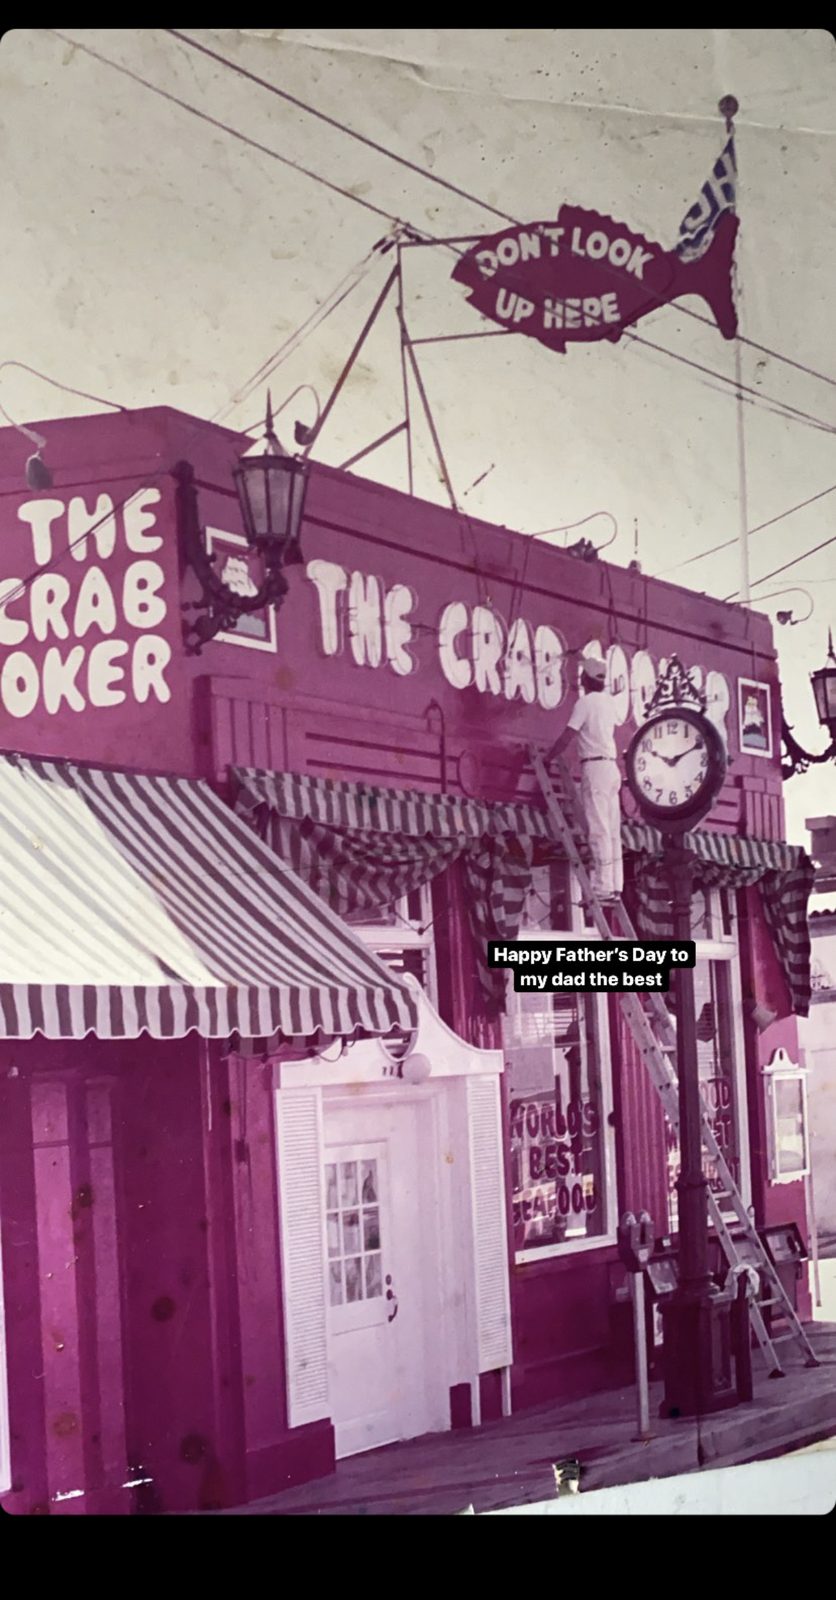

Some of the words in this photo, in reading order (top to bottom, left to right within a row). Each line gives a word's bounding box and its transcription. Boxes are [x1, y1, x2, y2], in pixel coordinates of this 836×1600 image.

[474, 224, 565, 278] DON'T
[571, 227, 654, 280] LOOK
[495, 288, 535, 323] UP
[543, 293, 621, 329] HERE
[17, 487, 164, 566] THE
[0, 560, 168, 646] CRAB
[306, 559, 416, 676] THE
[438, 601, 565, 710] CRAB
[666, 722, 678, 735] 12
[638, 756, 646, 771] 9
[643, 776, 652, 791] 8
[656, 788, 663, 802] 7
[669, 791, 677, 804] 6
[528, 1141, 592, 1180] BEST
